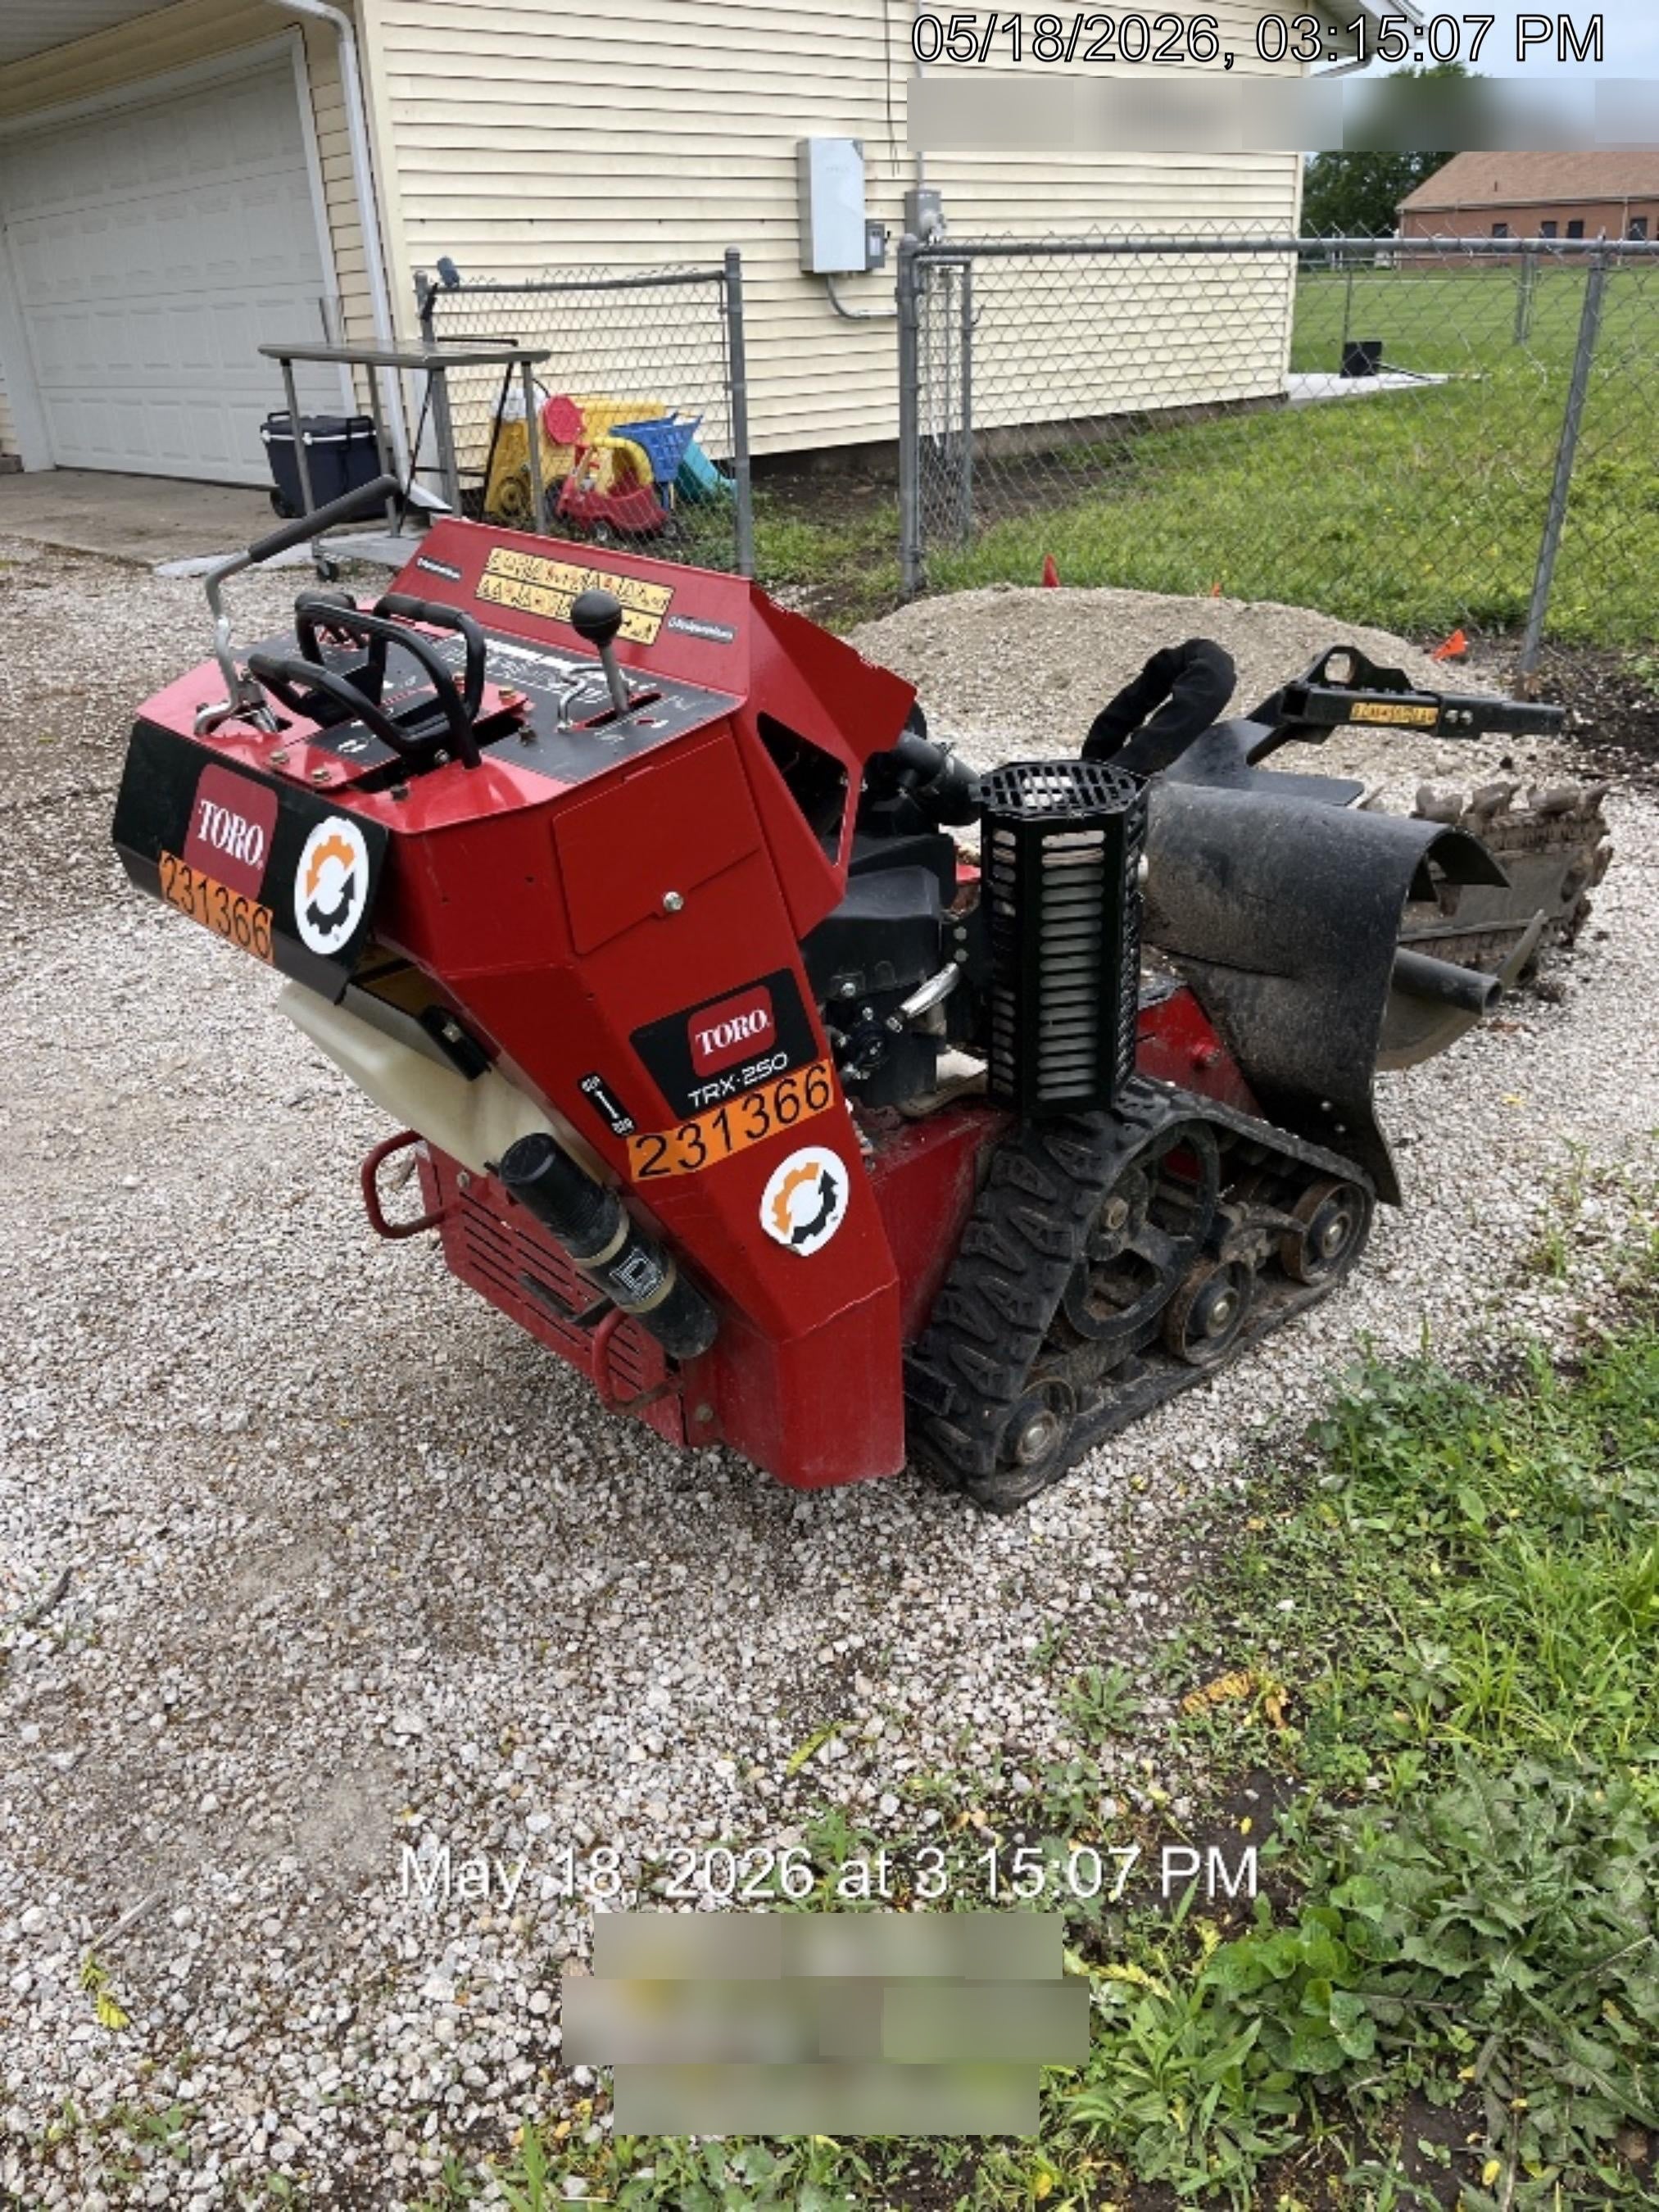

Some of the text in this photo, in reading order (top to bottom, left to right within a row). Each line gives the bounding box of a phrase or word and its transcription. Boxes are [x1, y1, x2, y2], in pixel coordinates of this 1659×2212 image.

[197, 799, 264, 867] TORO
[161, 855, 272, 959] 231366
[695, 1009, 768, 1056] TORO
[635, 1064, 831, 1178] 231366
